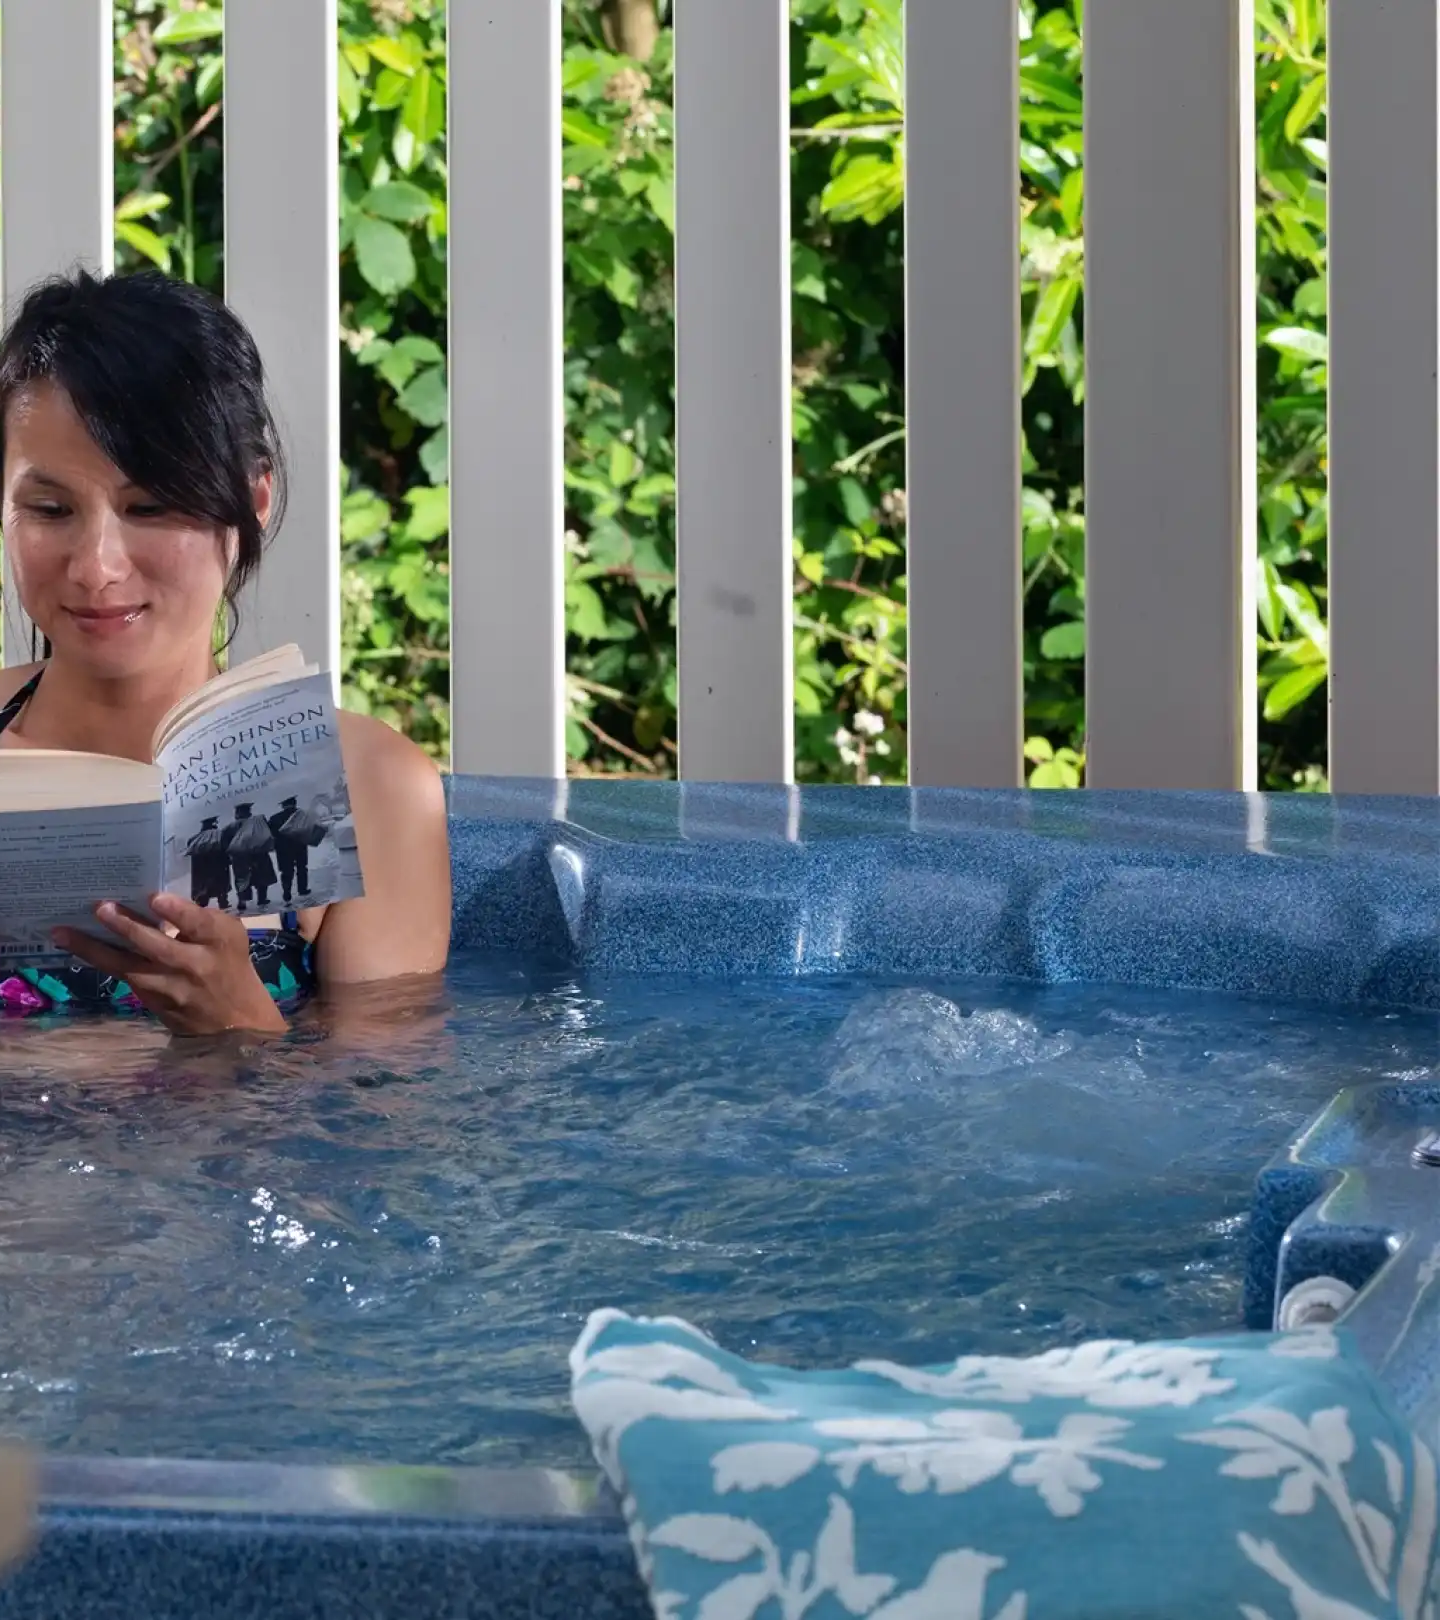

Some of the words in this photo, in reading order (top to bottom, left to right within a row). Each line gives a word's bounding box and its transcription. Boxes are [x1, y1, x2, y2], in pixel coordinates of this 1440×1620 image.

[212, 705, 324, 757] JOHNSON
[164, 757, 228, 804] LEASE,
[237, 723, 331, 764] MISTER
[179, 751, 298, 808] POSTMAN
[216, 781, 268, 801] MEMOIR
